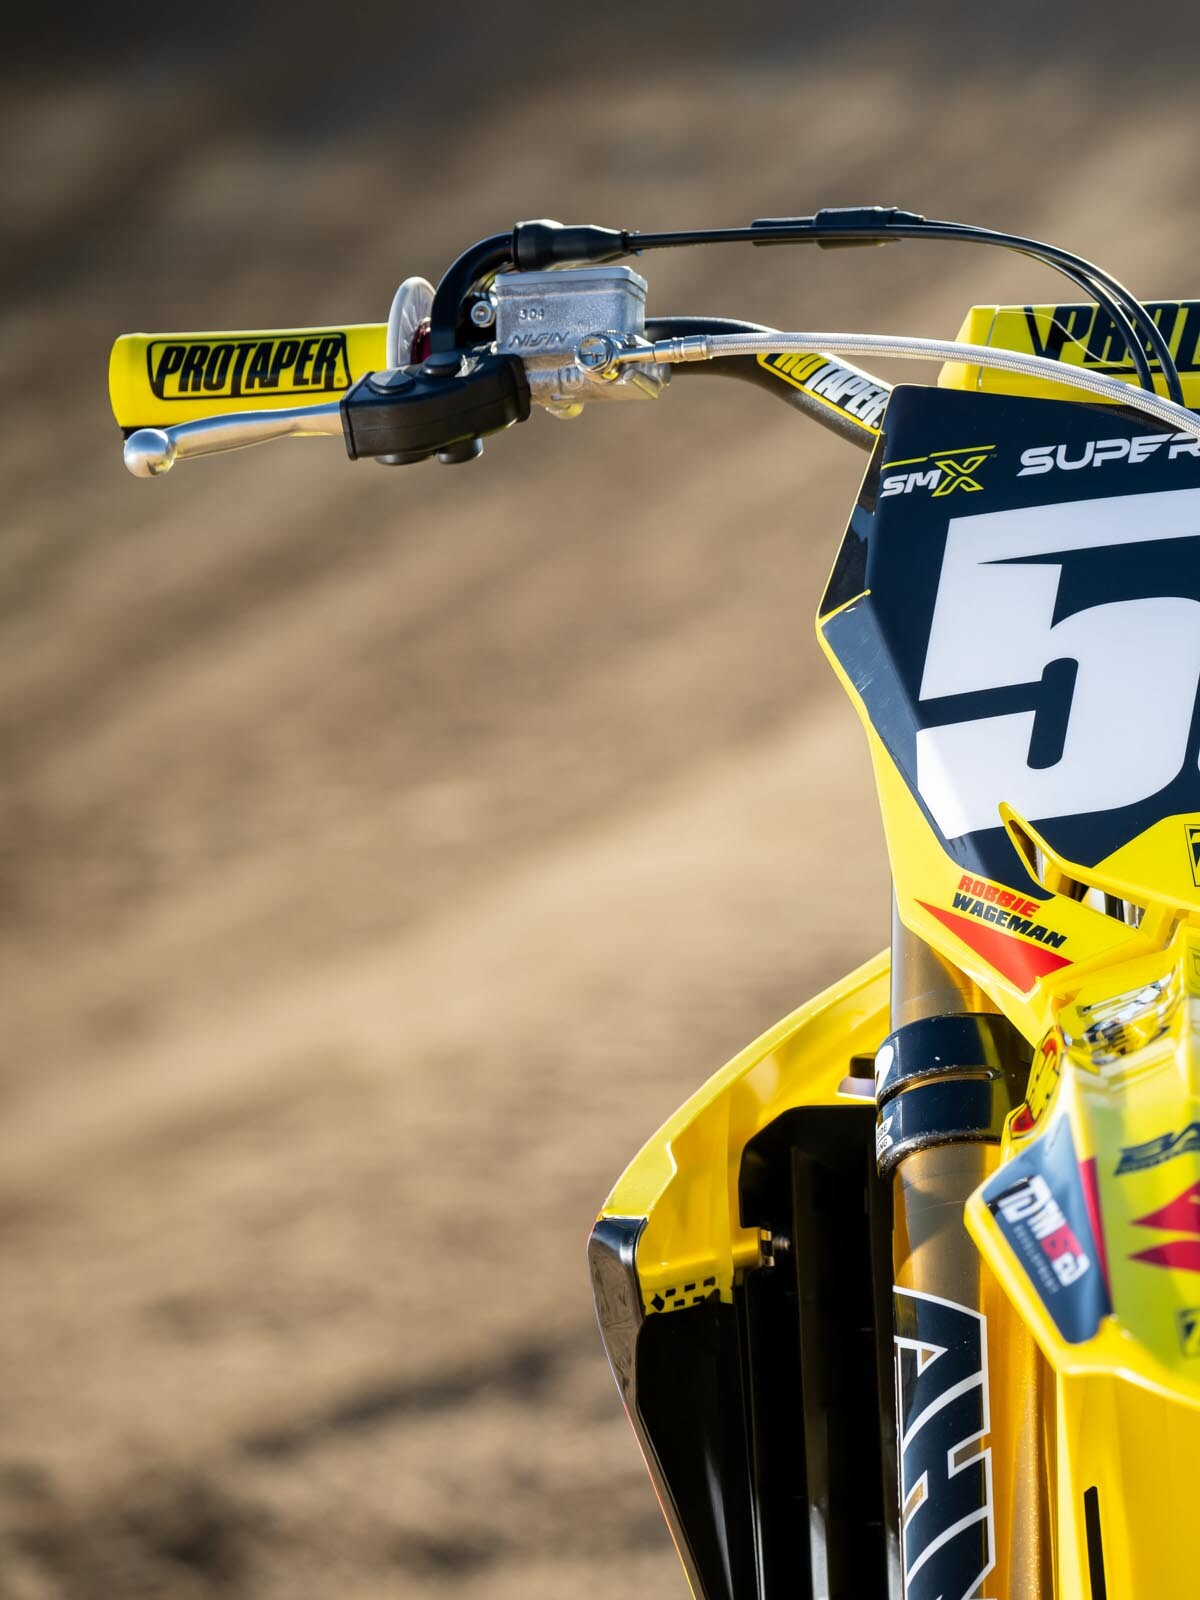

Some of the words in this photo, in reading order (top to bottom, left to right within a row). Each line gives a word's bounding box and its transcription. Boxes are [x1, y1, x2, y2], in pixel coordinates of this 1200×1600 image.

[157, 338, 341, 395] PROTAPER
[881, 454, 988, 498] SMX
[952, 892, 1068, 949] WAGEMAN
[957, 874, 1041, 918] ROBBIE
